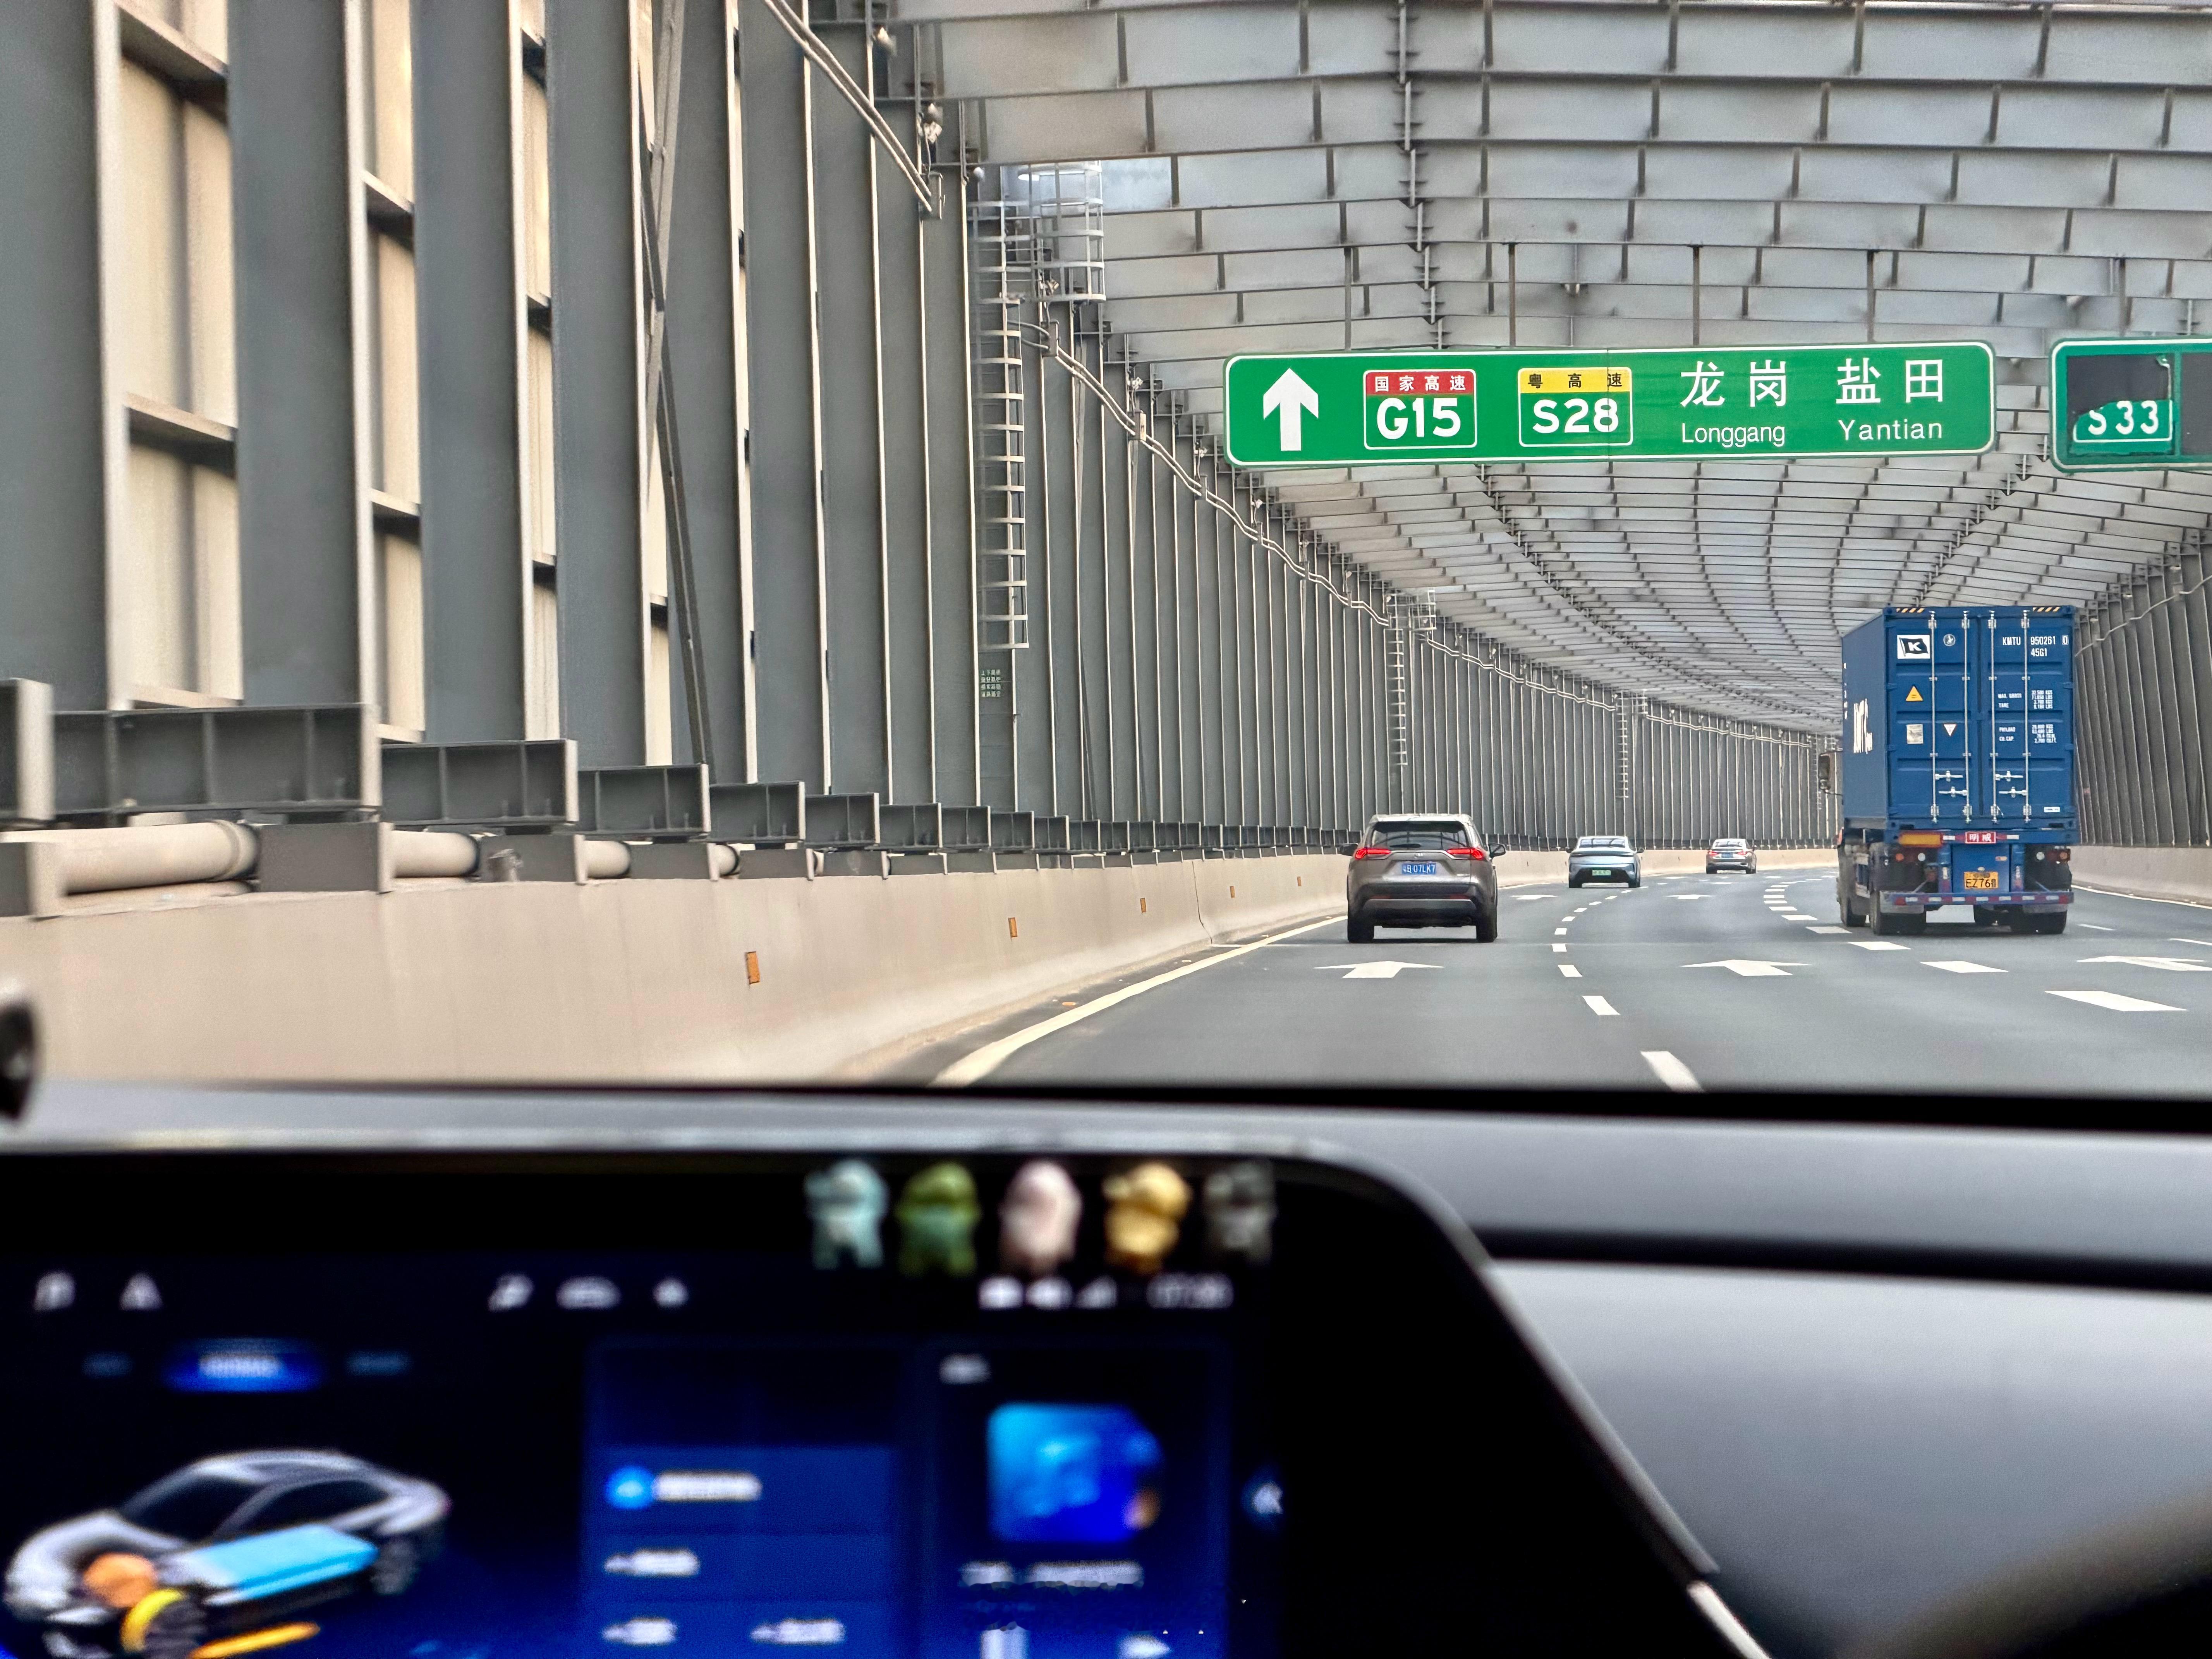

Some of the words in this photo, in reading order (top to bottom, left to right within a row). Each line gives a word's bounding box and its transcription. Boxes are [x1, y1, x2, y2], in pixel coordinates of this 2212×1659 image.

[1375, 374, 1466, 392] 国家高速
[1527, 372, 1623, 389] 粤高速
[1680, 359, 1787, 408] 龙岗
[1835, 357, 1943, 404] 盐田
[1376, 397, 1462, 440] G15
[1532, 398, 1619, 434] S28
[1681, 422, 1785, 448] Longgang
[1838, 418, 1942, 441] Yantian
[1908, 642, 1922, 651] K
[2002, 636, 2021, 646] KMTU
[2030, 635, 2056, 645] 950261
[2030, 647, 2047, 657] 45G1
[1966, 878, 1997, 888] EZ76
